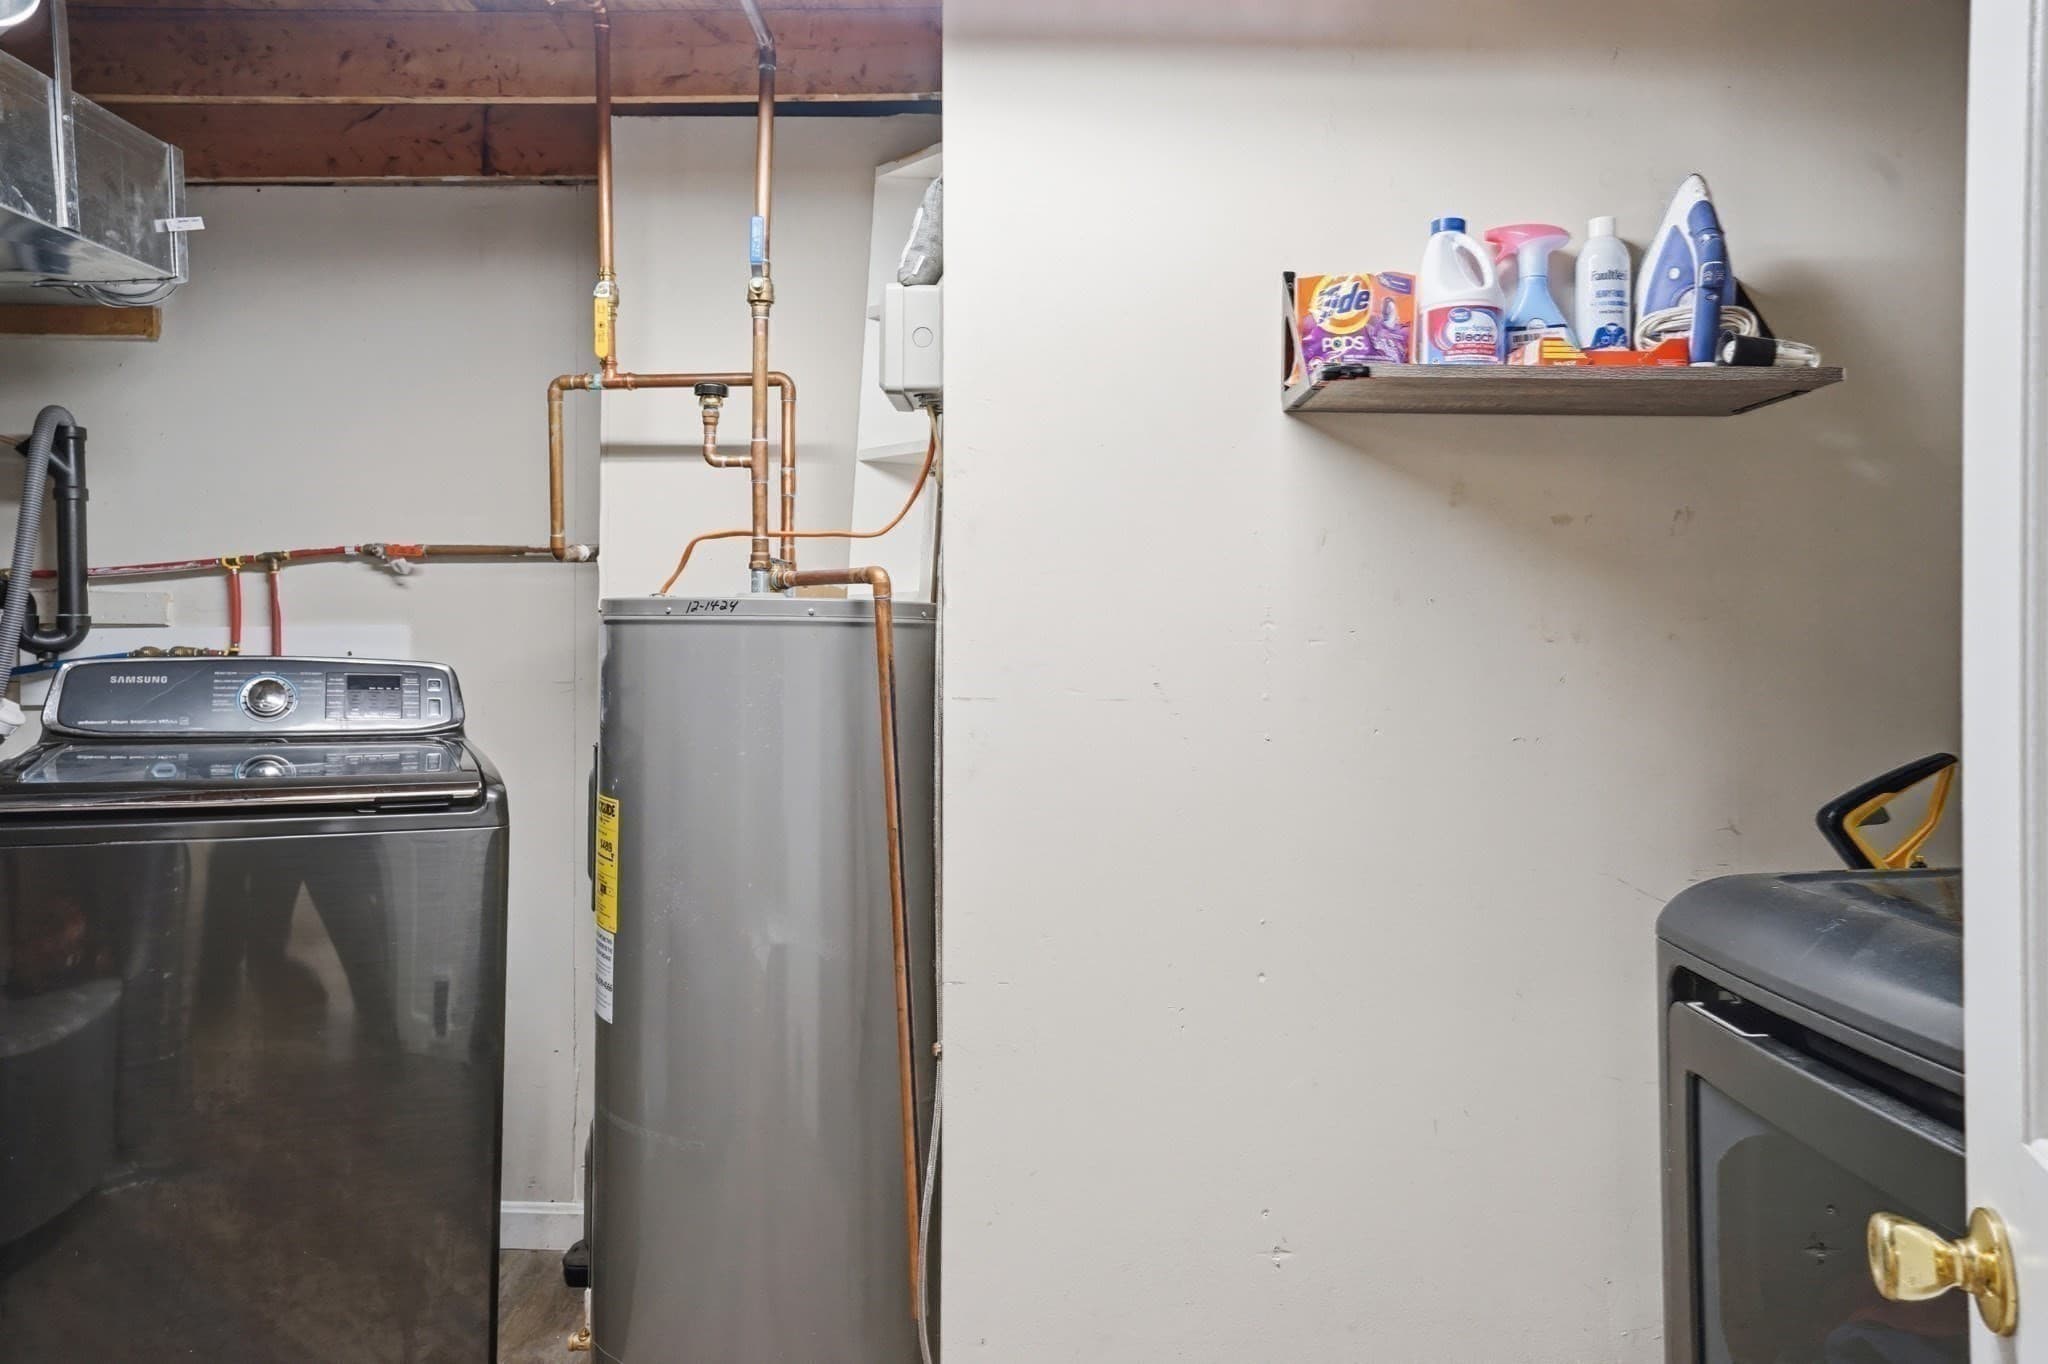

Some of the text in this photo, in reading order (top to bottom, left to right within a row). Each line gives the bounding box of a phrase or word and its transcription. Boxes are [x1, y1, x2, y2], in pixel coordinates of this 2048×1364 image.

[1318, 282, 1371, 324] Tide
[1321, 335, 1366, 352] PODS
[1454, 332, 1494, 343] Bleach
[685, 600, 739, 614] 12-1424
[109, 675, 168, 684] SAMSUNG
